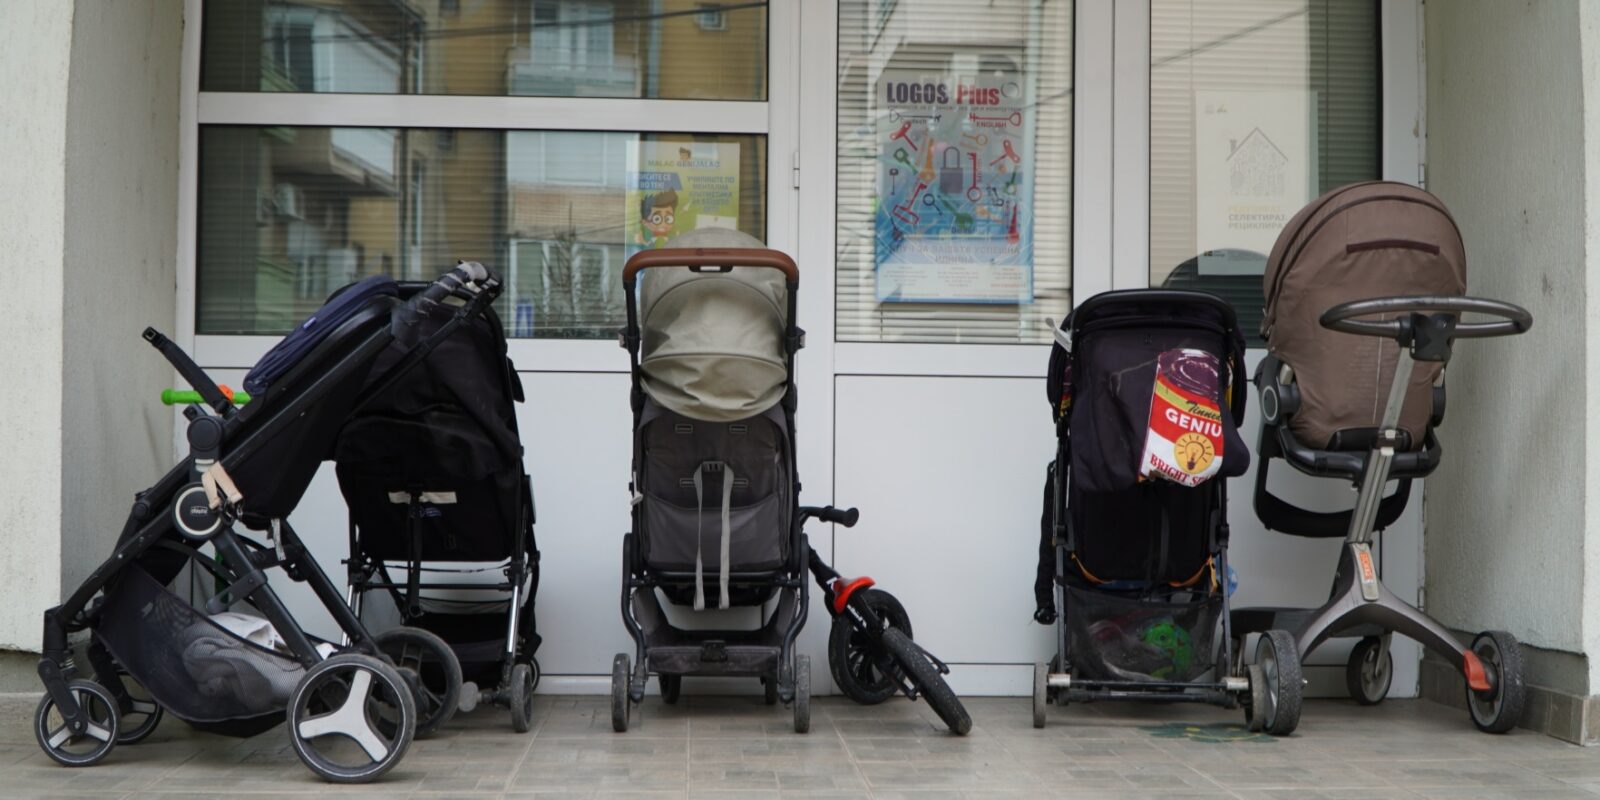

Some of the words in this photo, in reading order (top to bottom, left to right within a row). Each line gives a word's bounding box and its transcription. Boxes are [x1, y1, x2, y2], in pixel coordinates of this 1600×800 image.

[886, 82, 949, 104] LOGOS
[956, 82, 1000, 106] Plus
[648, 160, 674, 168] MALAC
[1228, 222, 1284, 230] РЕЦИКЛИРА
[1150, 453, 1189, 482] BRIGHT
